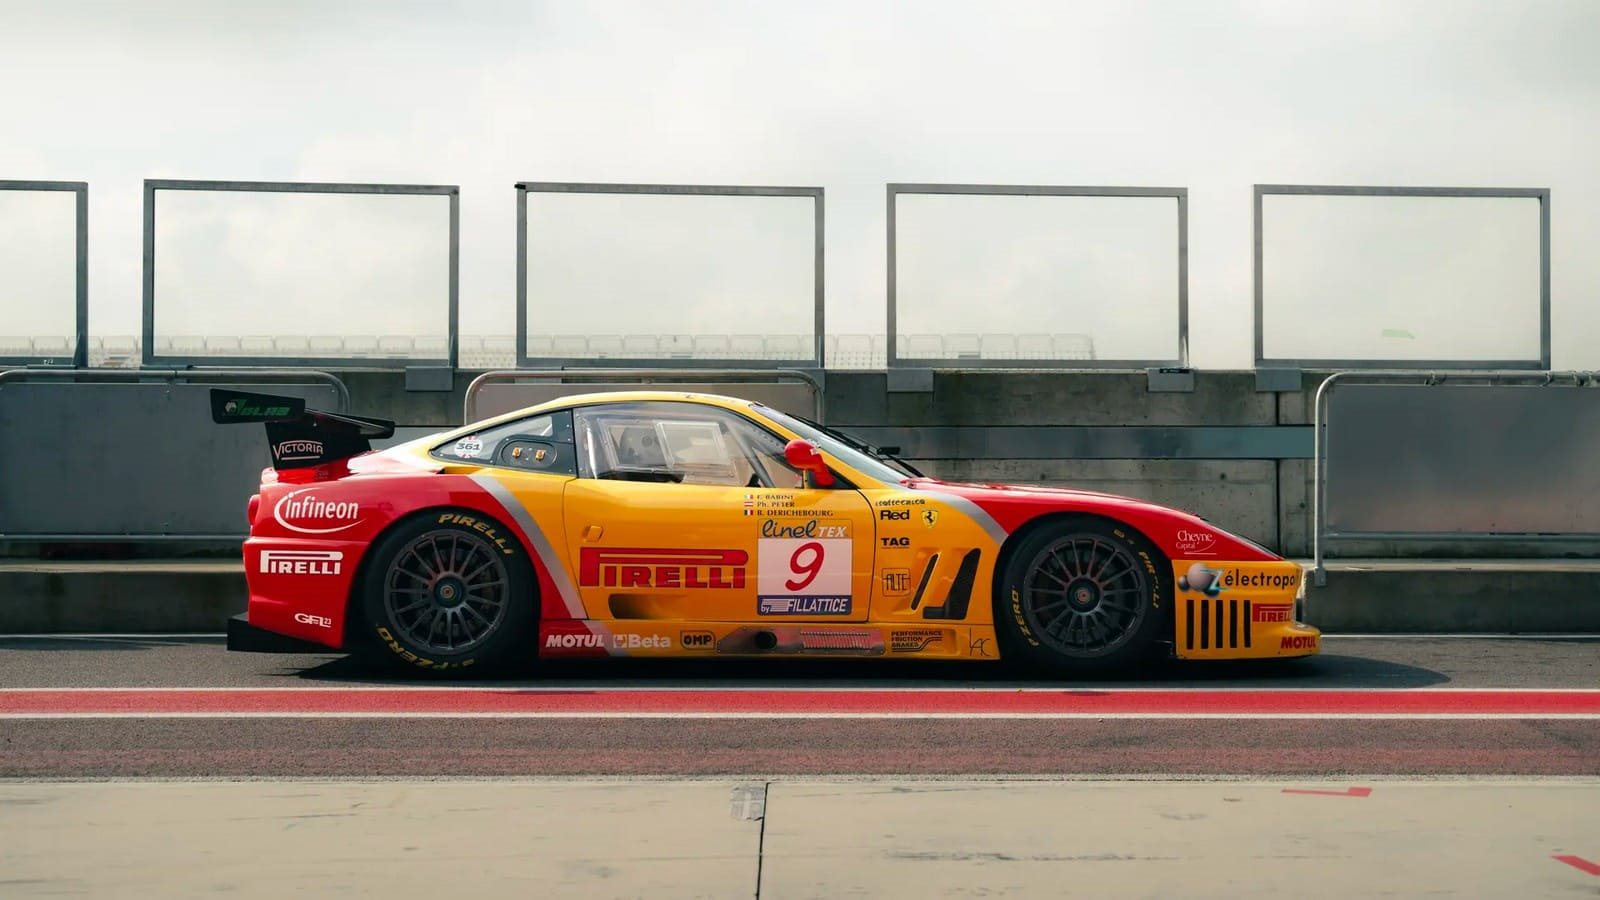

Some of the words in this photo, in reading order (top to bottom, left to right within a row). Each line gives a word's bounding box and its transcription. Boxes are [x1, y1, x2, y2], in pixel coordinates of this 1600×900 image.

[272, 440, 324, 460] VICTORIA
[456, 442, 480, 451] 361
[767, 509, 834, 517] DERICHEBOURG
[880, 509, 910, 521] Red
[438, 514, 514, 555] PIRELLI
[761, 519, 817, 539] linel
[818, 526, 848, 538] TEX
[881, 536, 910, 547] TAG
[1177, 530, 1213, 545] Cheyne
[260, 550, 344, 575] PIRELLI
[579, 547, 749, 589] PIRELLI
[784, 541, 826, 593] 9
[786, 598, 849, 613] FILLATTICE
[546, 634, 605, 649] MOTUL
[628, 634, 672, 648] Beta
[683, 635, 713, 646] OMP
